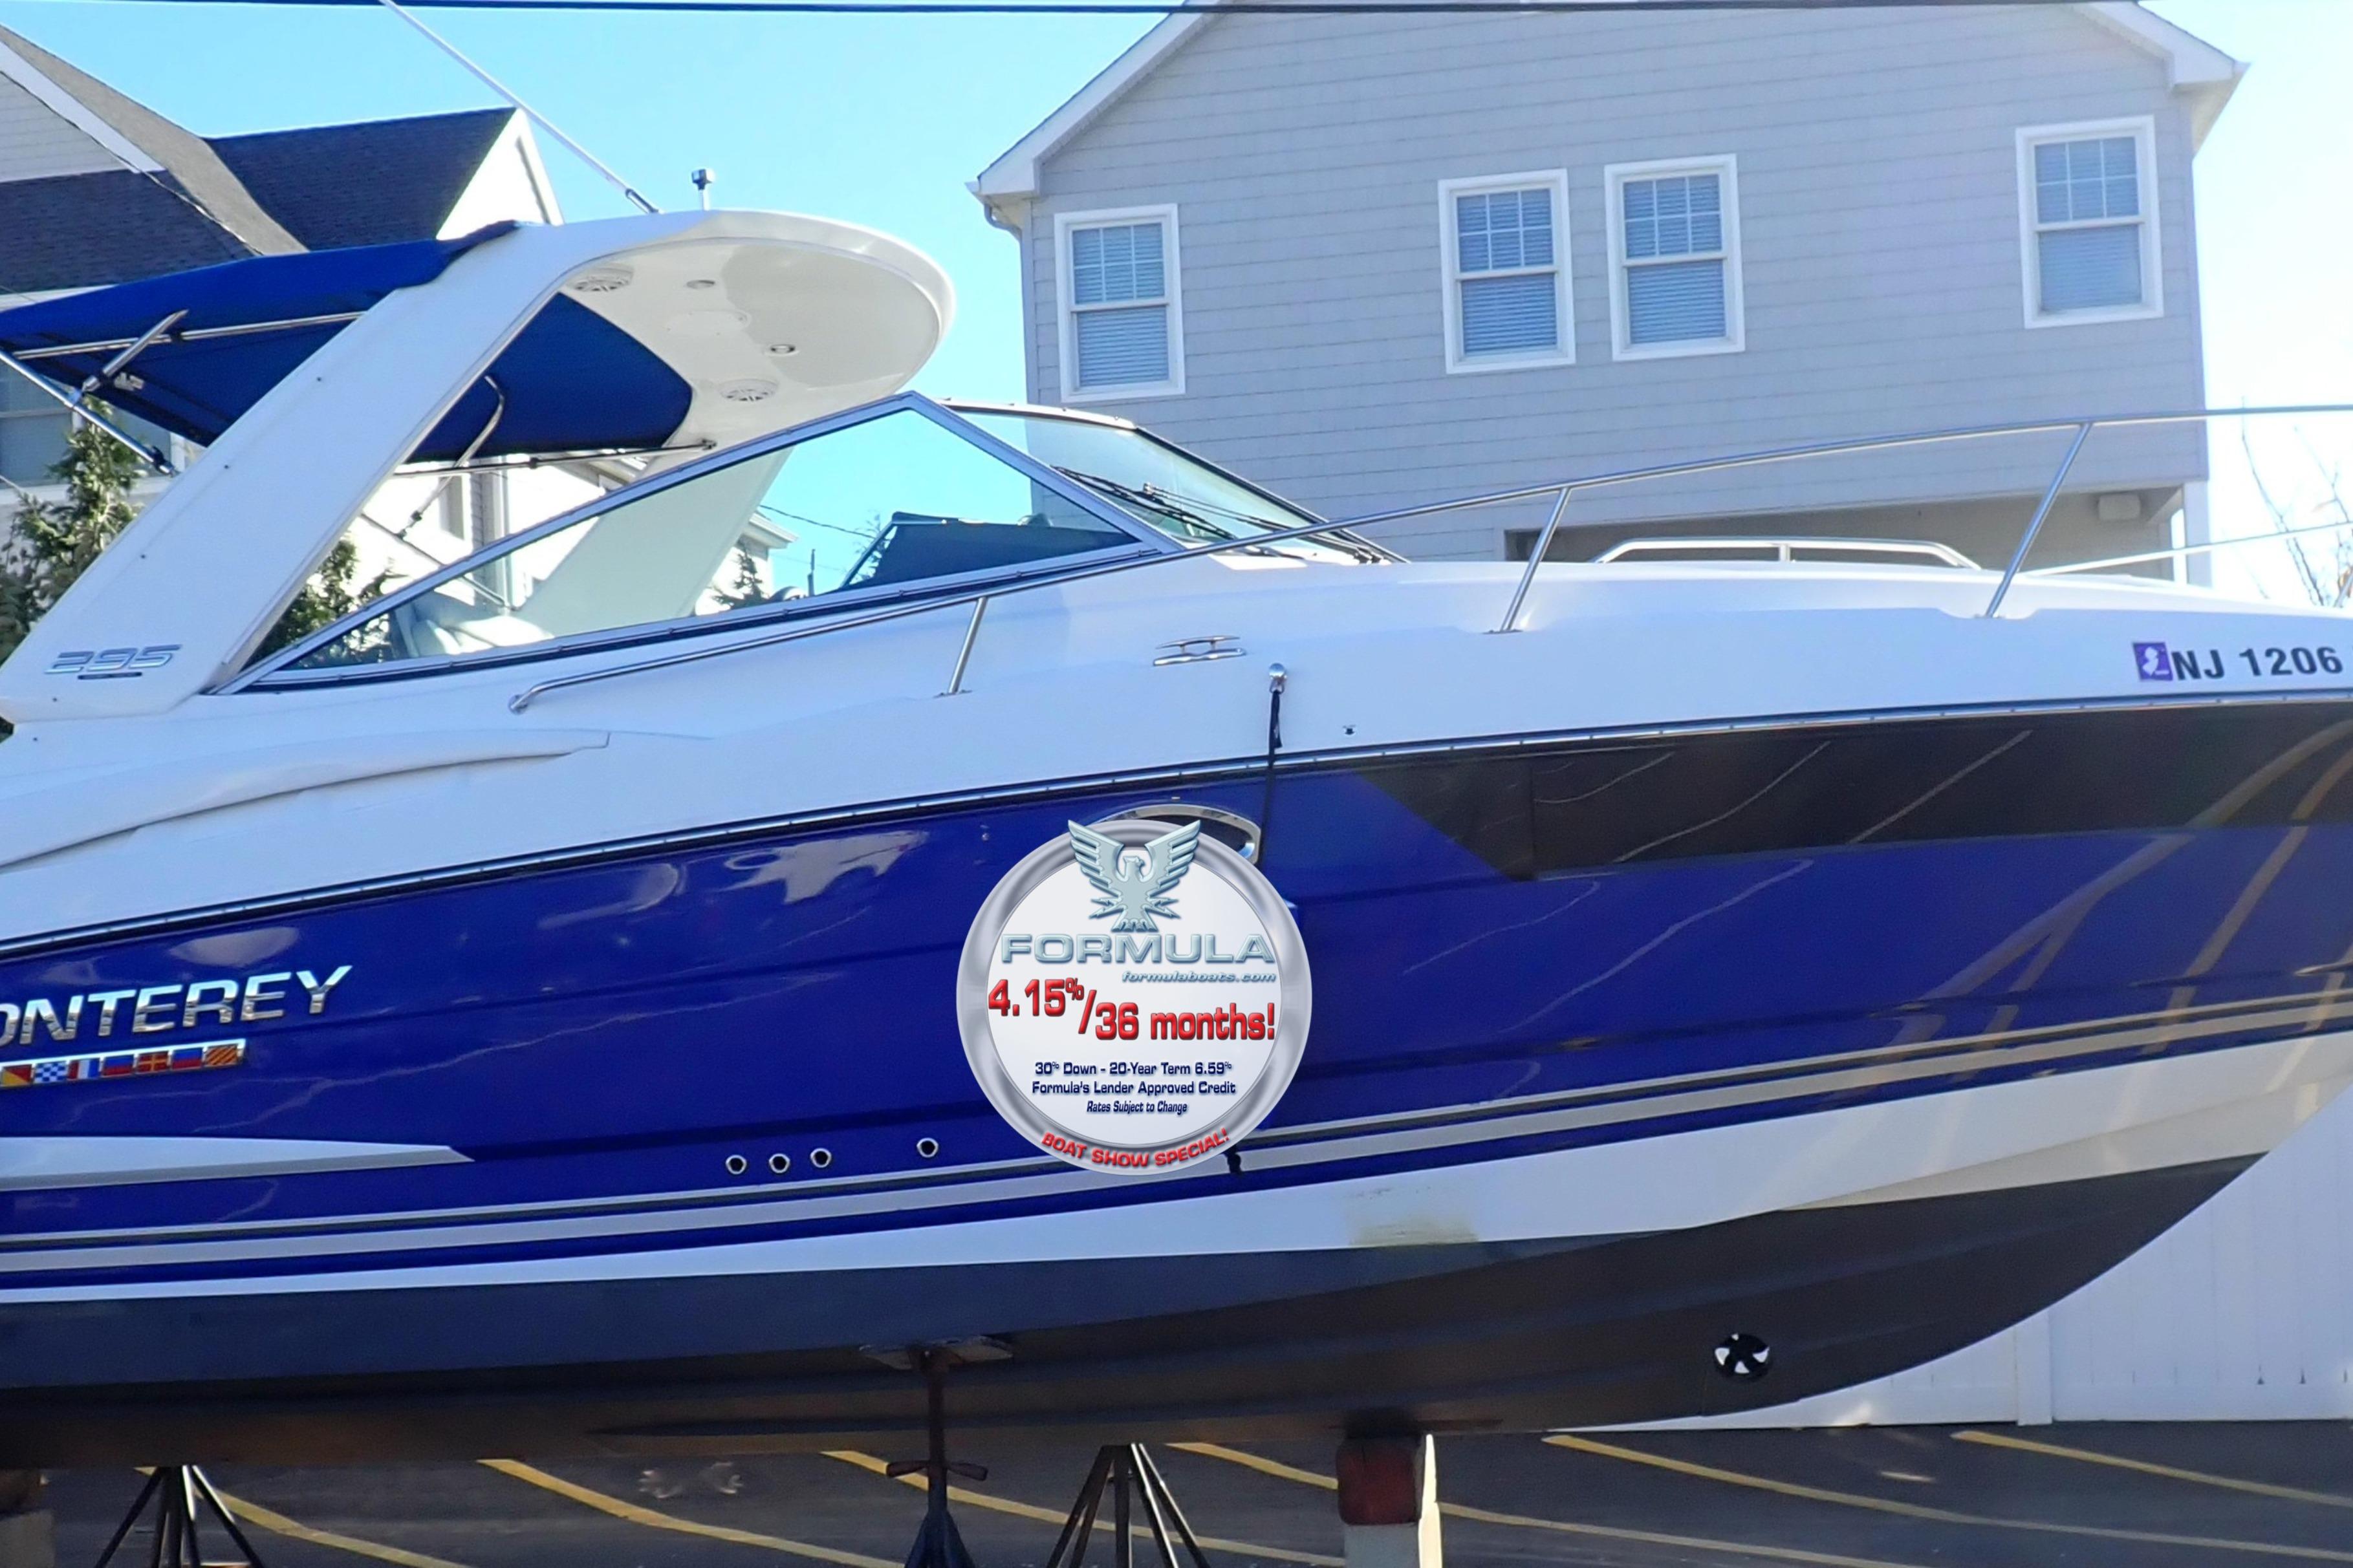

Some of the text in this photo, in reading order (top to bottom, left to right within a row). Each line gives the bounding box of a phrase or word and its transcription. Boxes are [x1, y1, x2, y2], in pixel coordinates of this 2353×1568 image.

[44, 645, 182, 674] 295
[2171, 647, 2344, 680] NJ 1206
